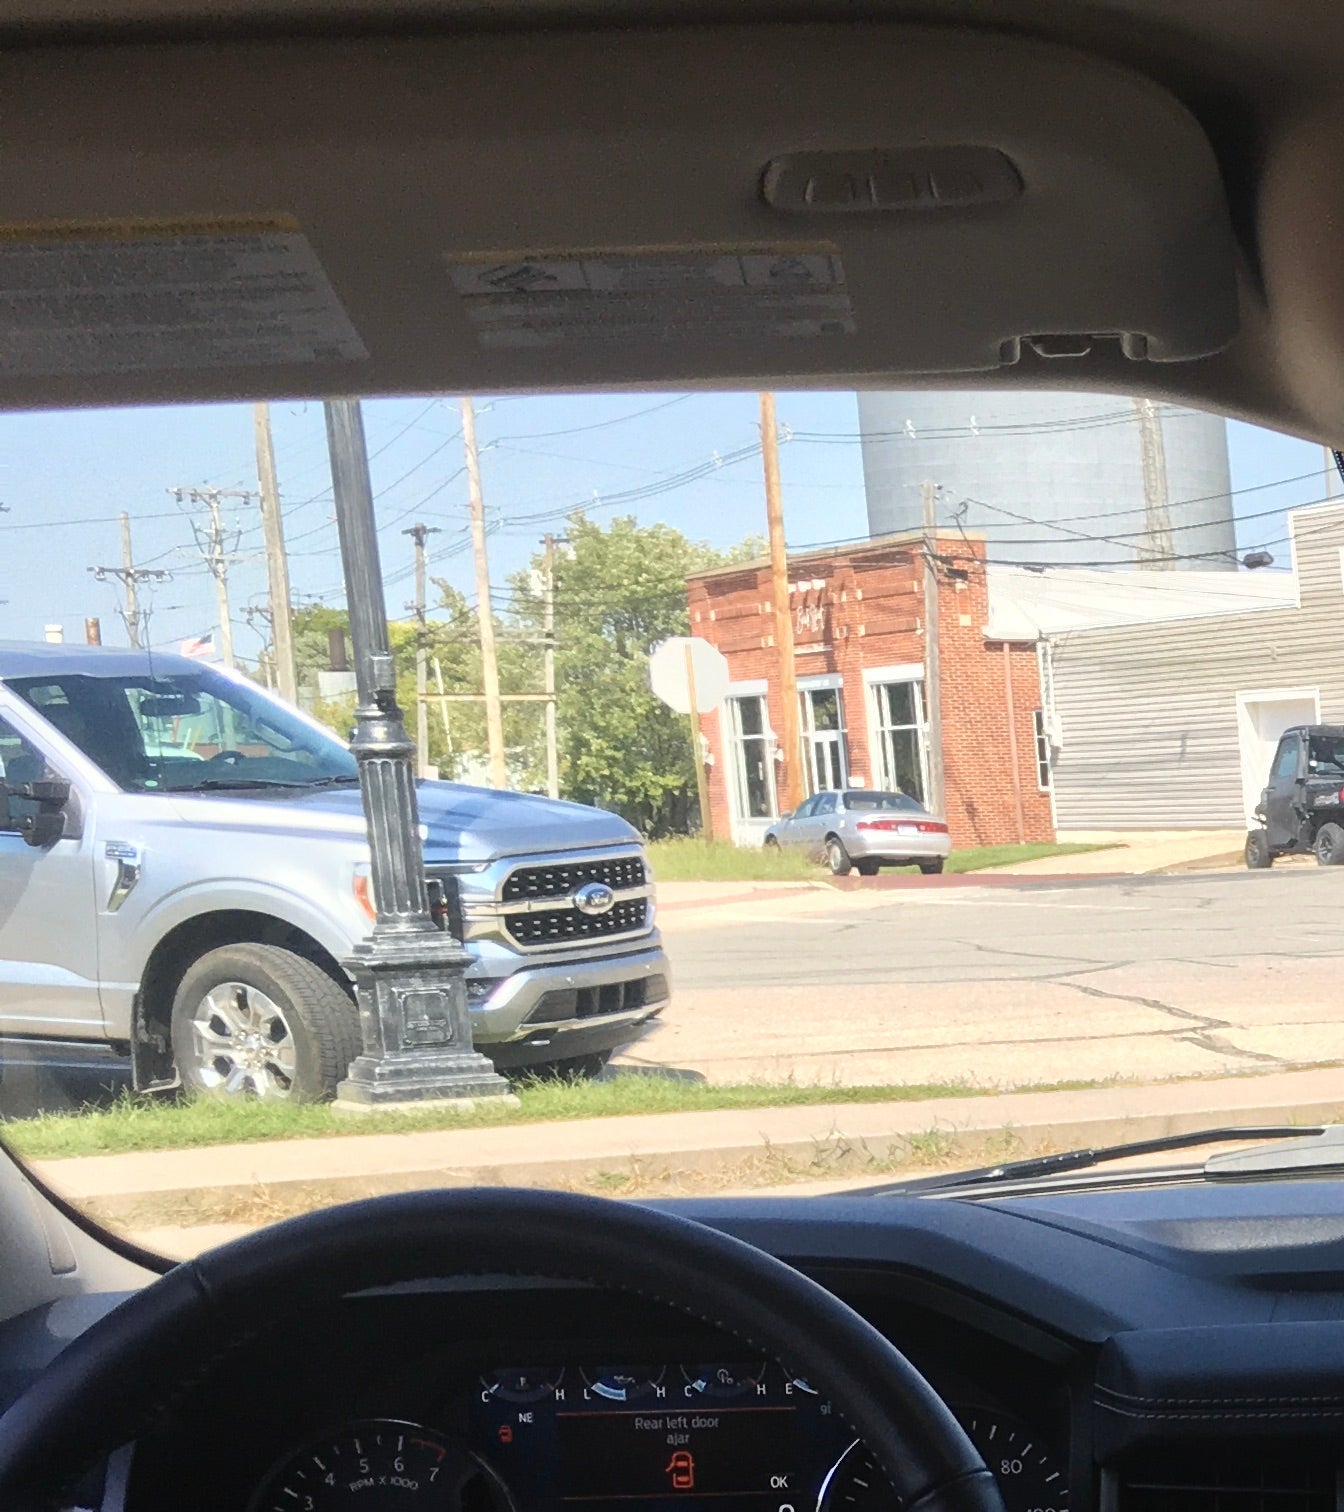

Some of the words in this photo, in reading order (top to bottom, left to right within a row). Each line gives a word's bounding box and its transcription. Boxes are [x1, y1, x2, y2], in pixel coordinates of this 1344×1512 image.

[555, 1389, 565, 1401] H
[583, 1388, 591, 1400] L
[656, 1386, 666, 1398] H
[684, 1385, 693, 1398] C
[756, 1383, 766, 1395] H
[785, 1382, 793, 1395] E
[480, 1390, 490, 1403] C
[518, 1412, 534, 1424] NE
[635, 1416, 664, 1430] Rear
[666, 1415, 689, 1430] left
[691, 1415, 719, 1429] door
[667, 1432, 691, 1446] ajar
[359, 1457, 370, 1473] 5
[393, 1456, 405, 1471] 6
[1001, 1459, 1023, 1474] 80
[324, 1472, 335, 1487] 4
[428, 1466, 440, 1482] 7
[349, 1477, 375, 1493] RPM
[390, 1475, 419, 1491] 1000
[769, 1476, 789, 1489] OK
[303, 1495, 314, 1511] 3
